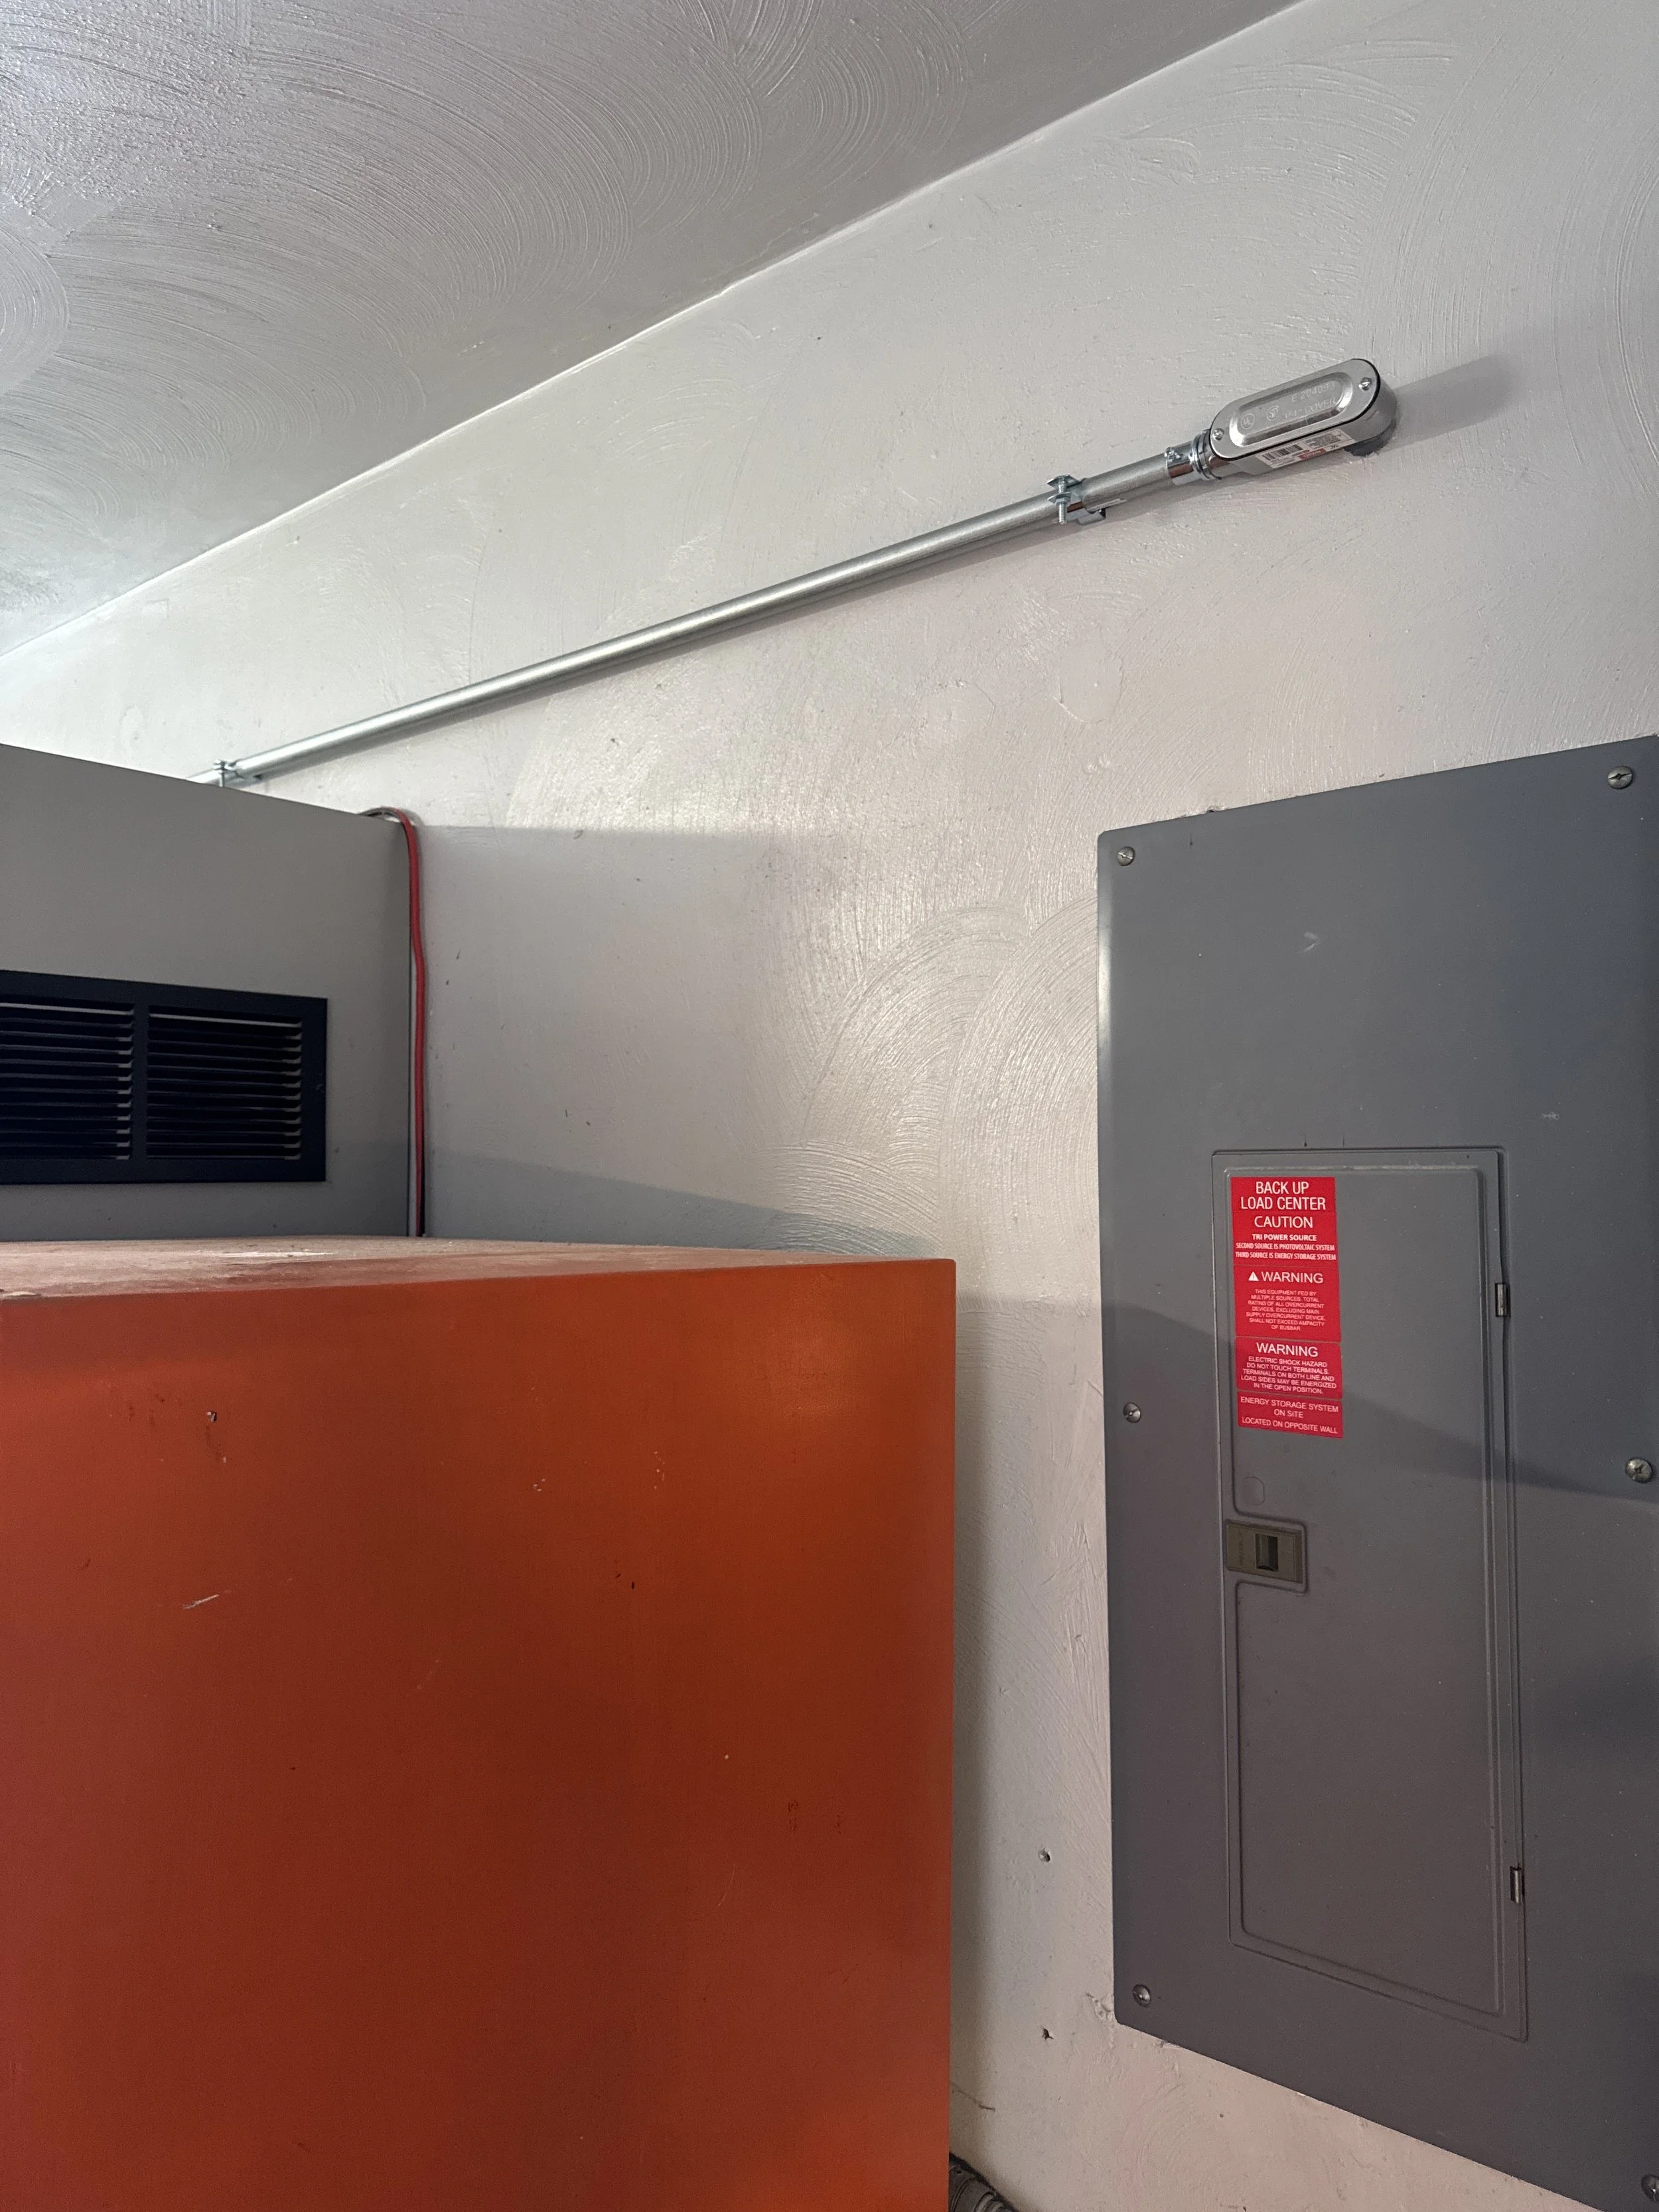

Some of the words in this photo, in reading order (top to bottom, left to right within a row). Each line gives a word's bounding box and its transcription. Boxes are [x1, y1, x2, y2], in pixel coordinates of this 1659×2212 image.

[1256, 1181, 1289, 1194] BACK
[1293, 1182, 1309, 1194] UP
[1241, 1197, 1272, 1210] LOAD
[1277, 1197, 1326, 1210] CENTER
[1254, 1216, 1313, 1228] CAUTION
[1262, 1272, 1323, 1284] WARNING
[1256, 1342, 1318, 1357] WARNING
[1241, 1396, 1269, 1405] ENERGY
[1271, 1400, 1306, 1409] STORAGE
[1309, 1403, 1338, 1412] SYSTEM
[1242, 1417, 1271, 1426] LOCATED
[1285, 1422, 1318, 1431] OPPOSITE
